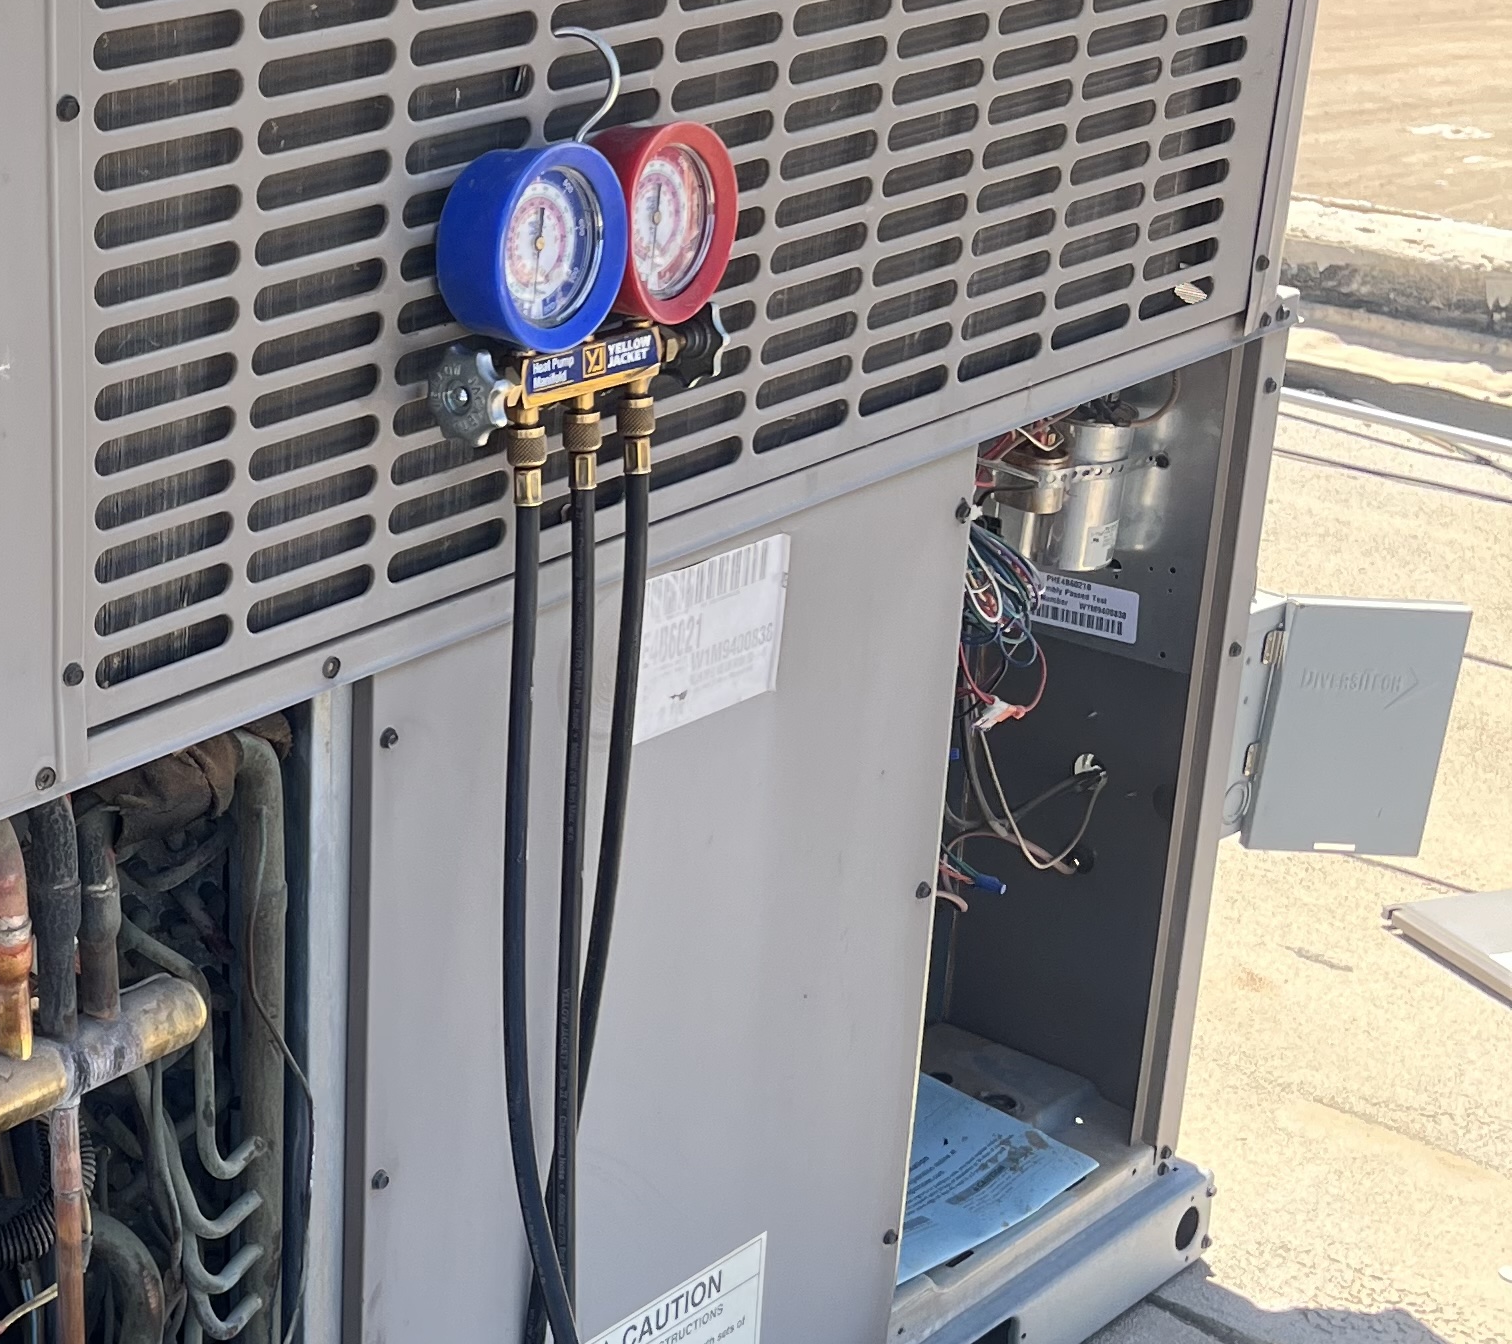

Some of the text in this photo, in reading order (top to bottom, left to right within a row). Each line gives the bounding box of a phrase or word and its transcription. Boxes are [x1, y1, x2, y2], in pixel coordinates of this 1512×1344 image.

[608, 335, 652, 354] YELLOW
[532, 356, 575, 375] Heat Pump
[585, 348, 605, 373] YJ
[608, 348, 649, 368] JACKET
[1064, 588, 1090, 601] Passed
[1092, 595, 1107, 605] Test
[561, 987, 572, 1024] YELLOW
[717, 1323, 735, 1342] sets
[736, 1315, 746, 1329] of
